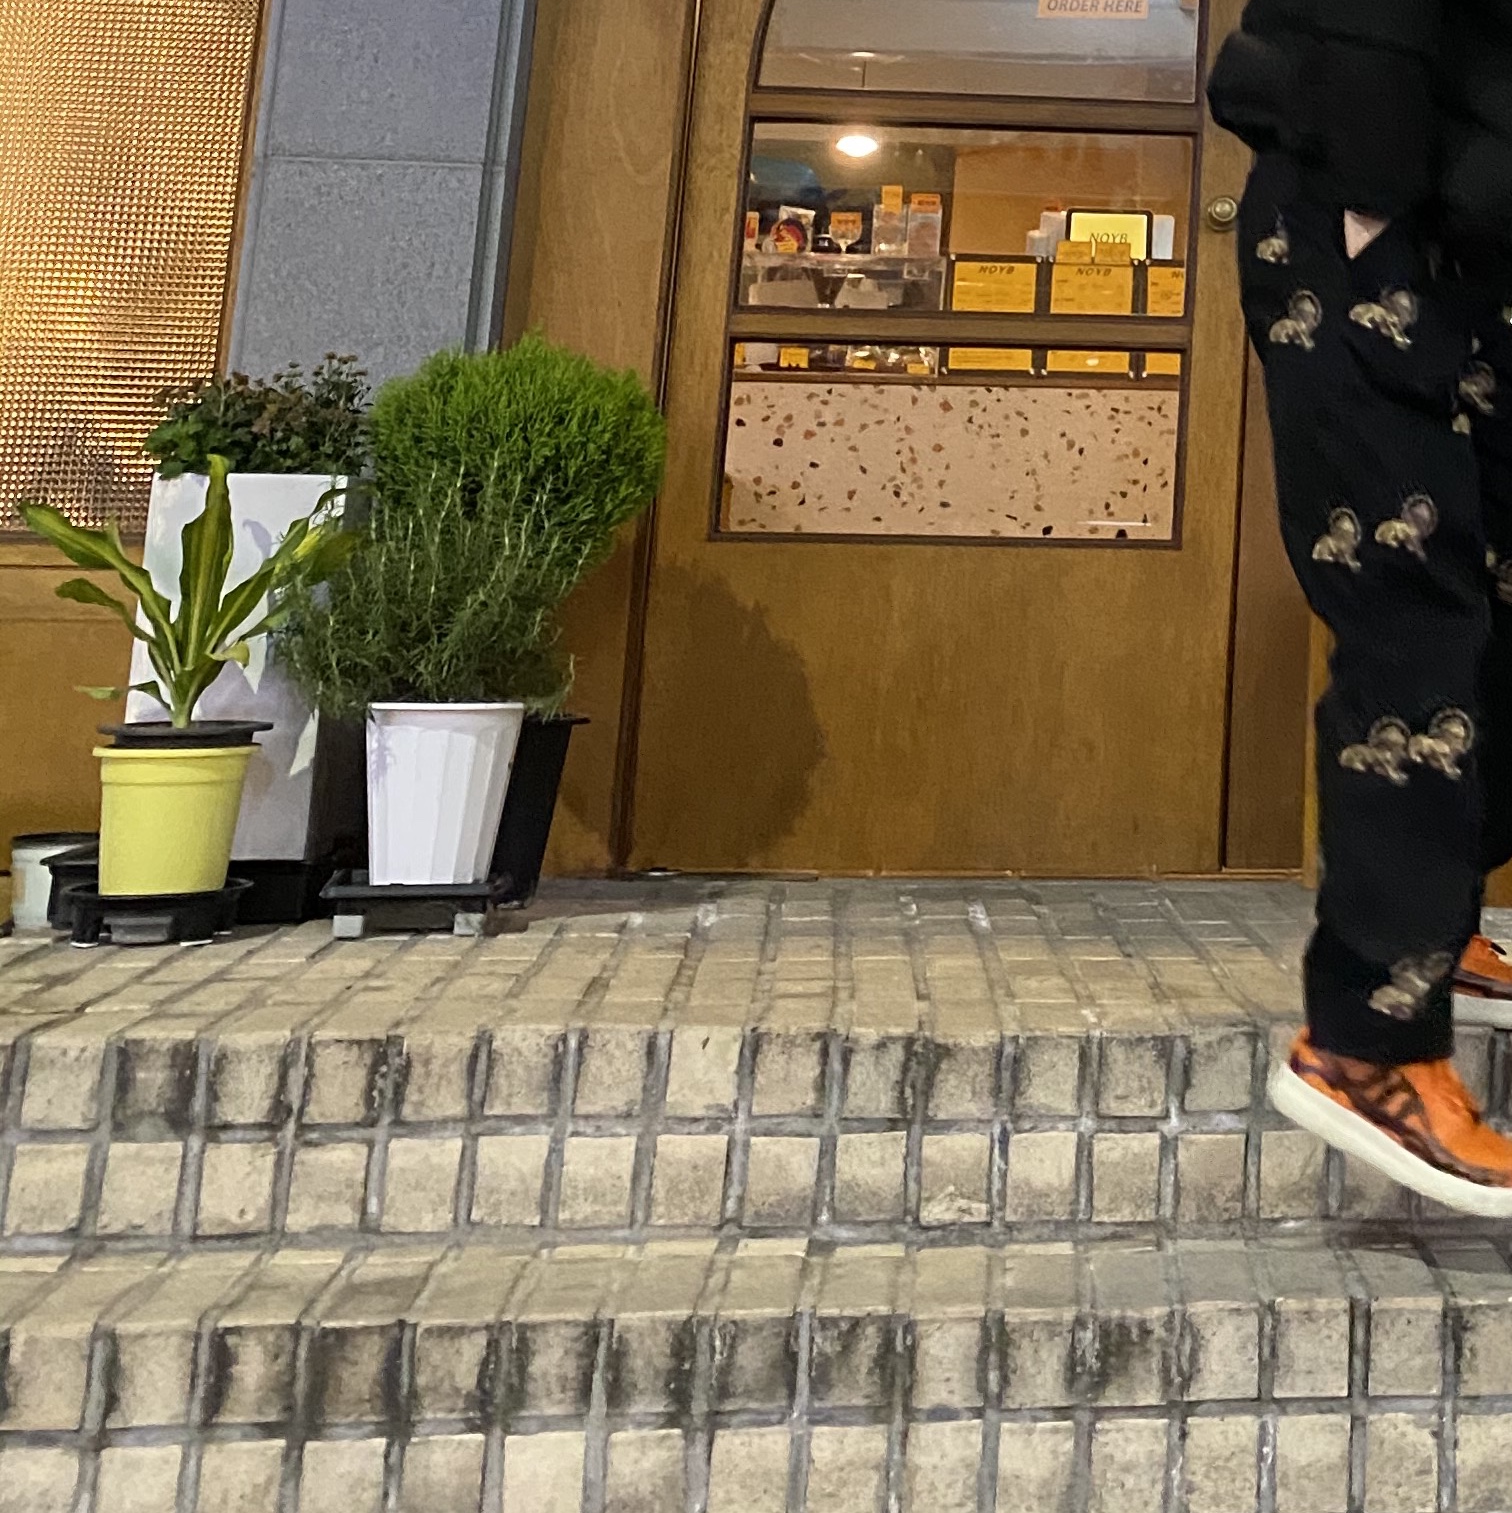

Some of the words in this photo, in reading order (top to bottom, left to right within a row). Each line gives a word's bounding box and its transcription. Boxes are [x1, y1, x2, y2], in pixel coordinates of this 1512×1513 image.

[1103, 0, 1145, 14] HERE
[1089, 232, 1128, 244] NOYB
[978, 265, 1016, 275] NOYB
[1075, 267, 1112, 277] NOYB
